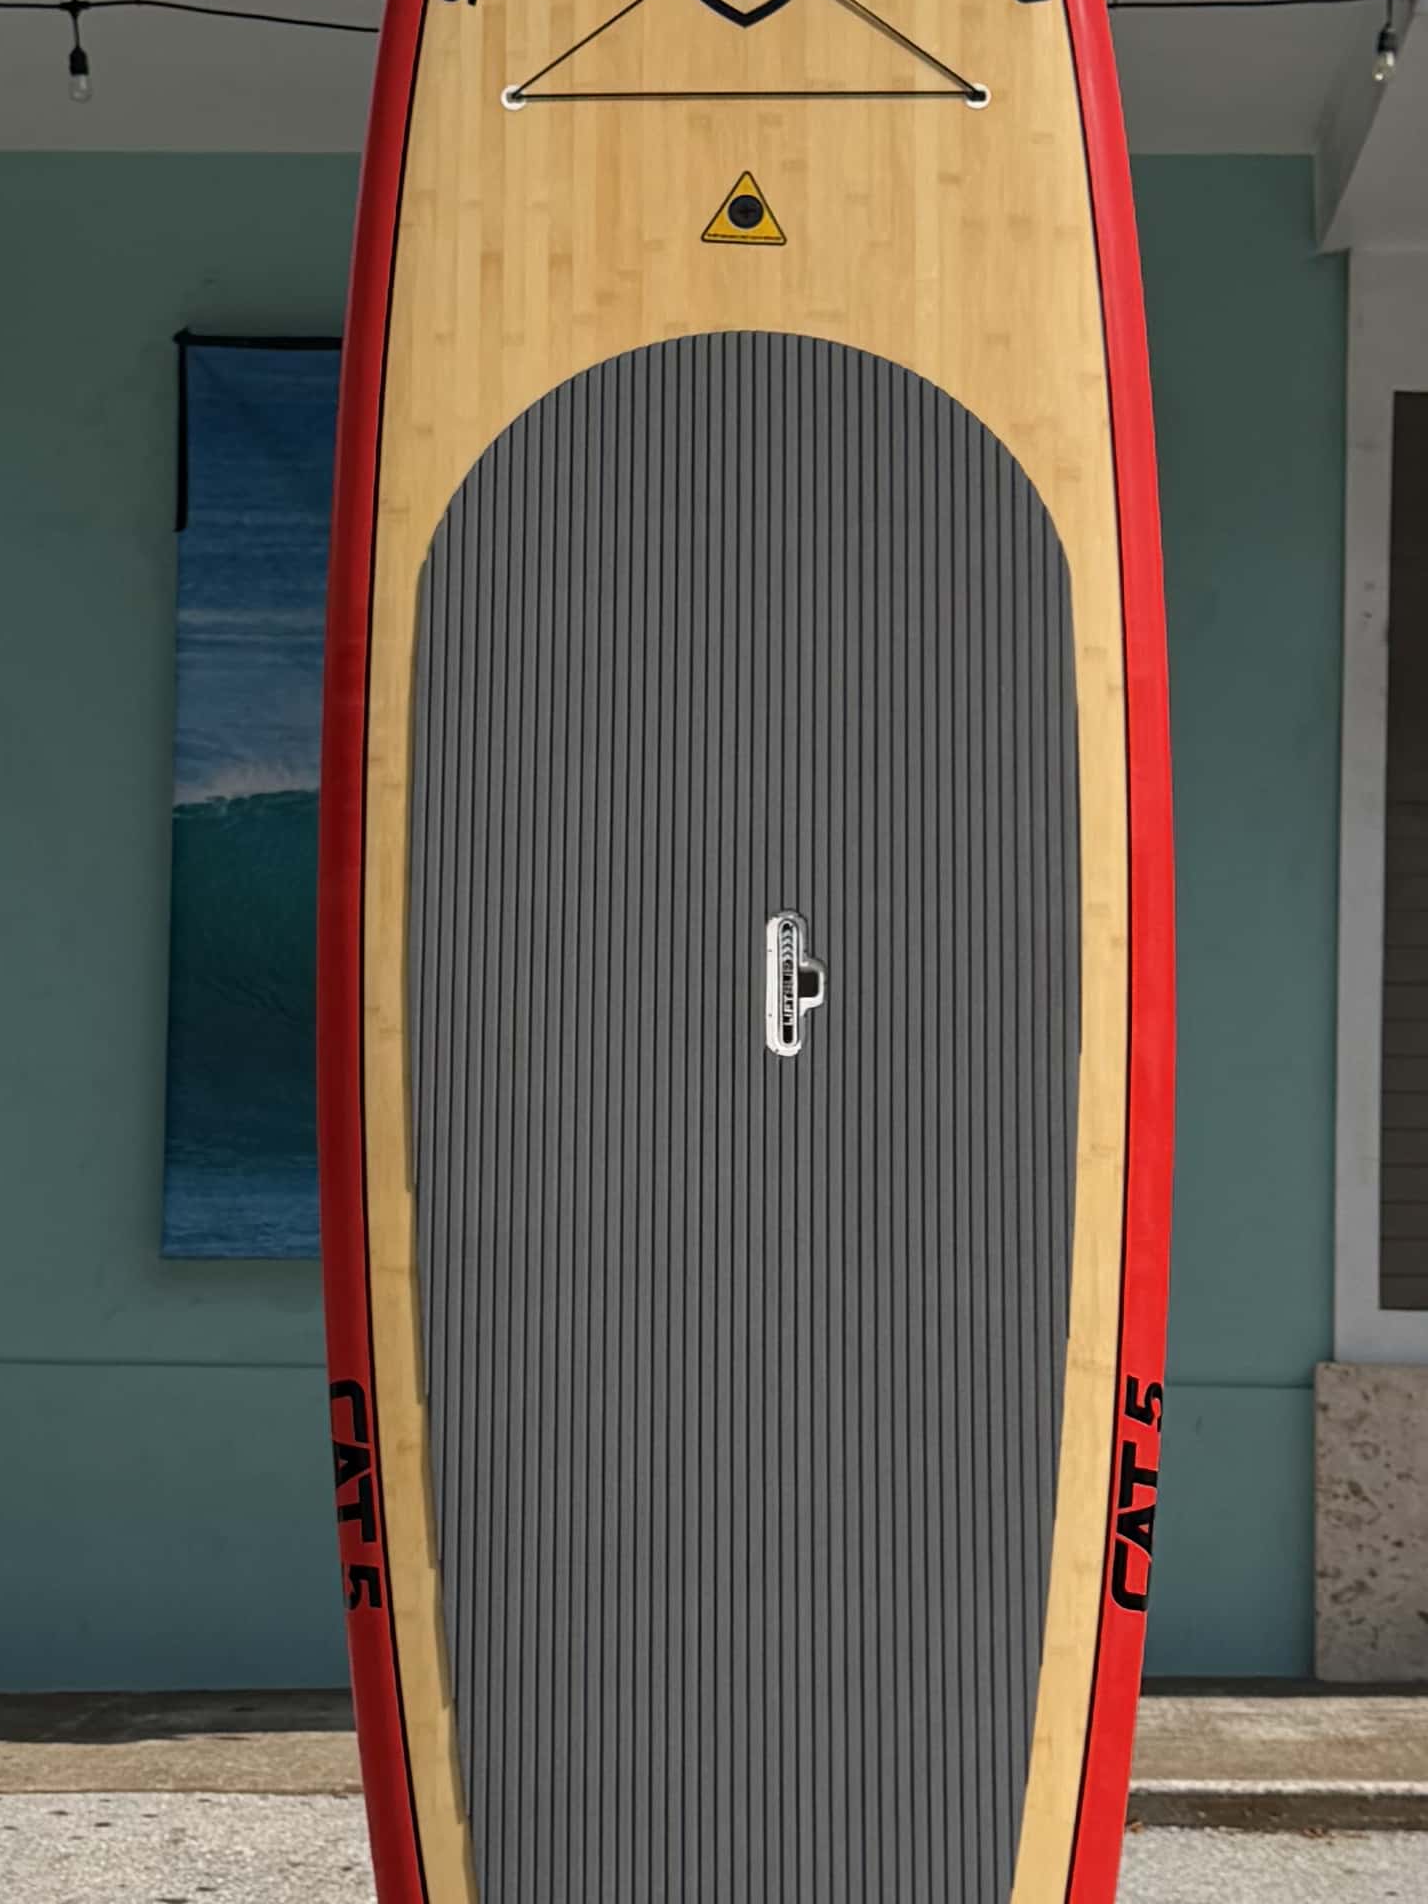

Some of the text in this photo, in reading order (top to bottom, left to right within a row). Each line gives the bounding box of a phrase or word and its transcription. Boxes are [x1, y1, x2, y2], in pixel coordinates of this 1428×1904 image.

[330, 1381, 381, 1610] CAT 5
[1112, 1375, 1162, 1610] CAT 5
